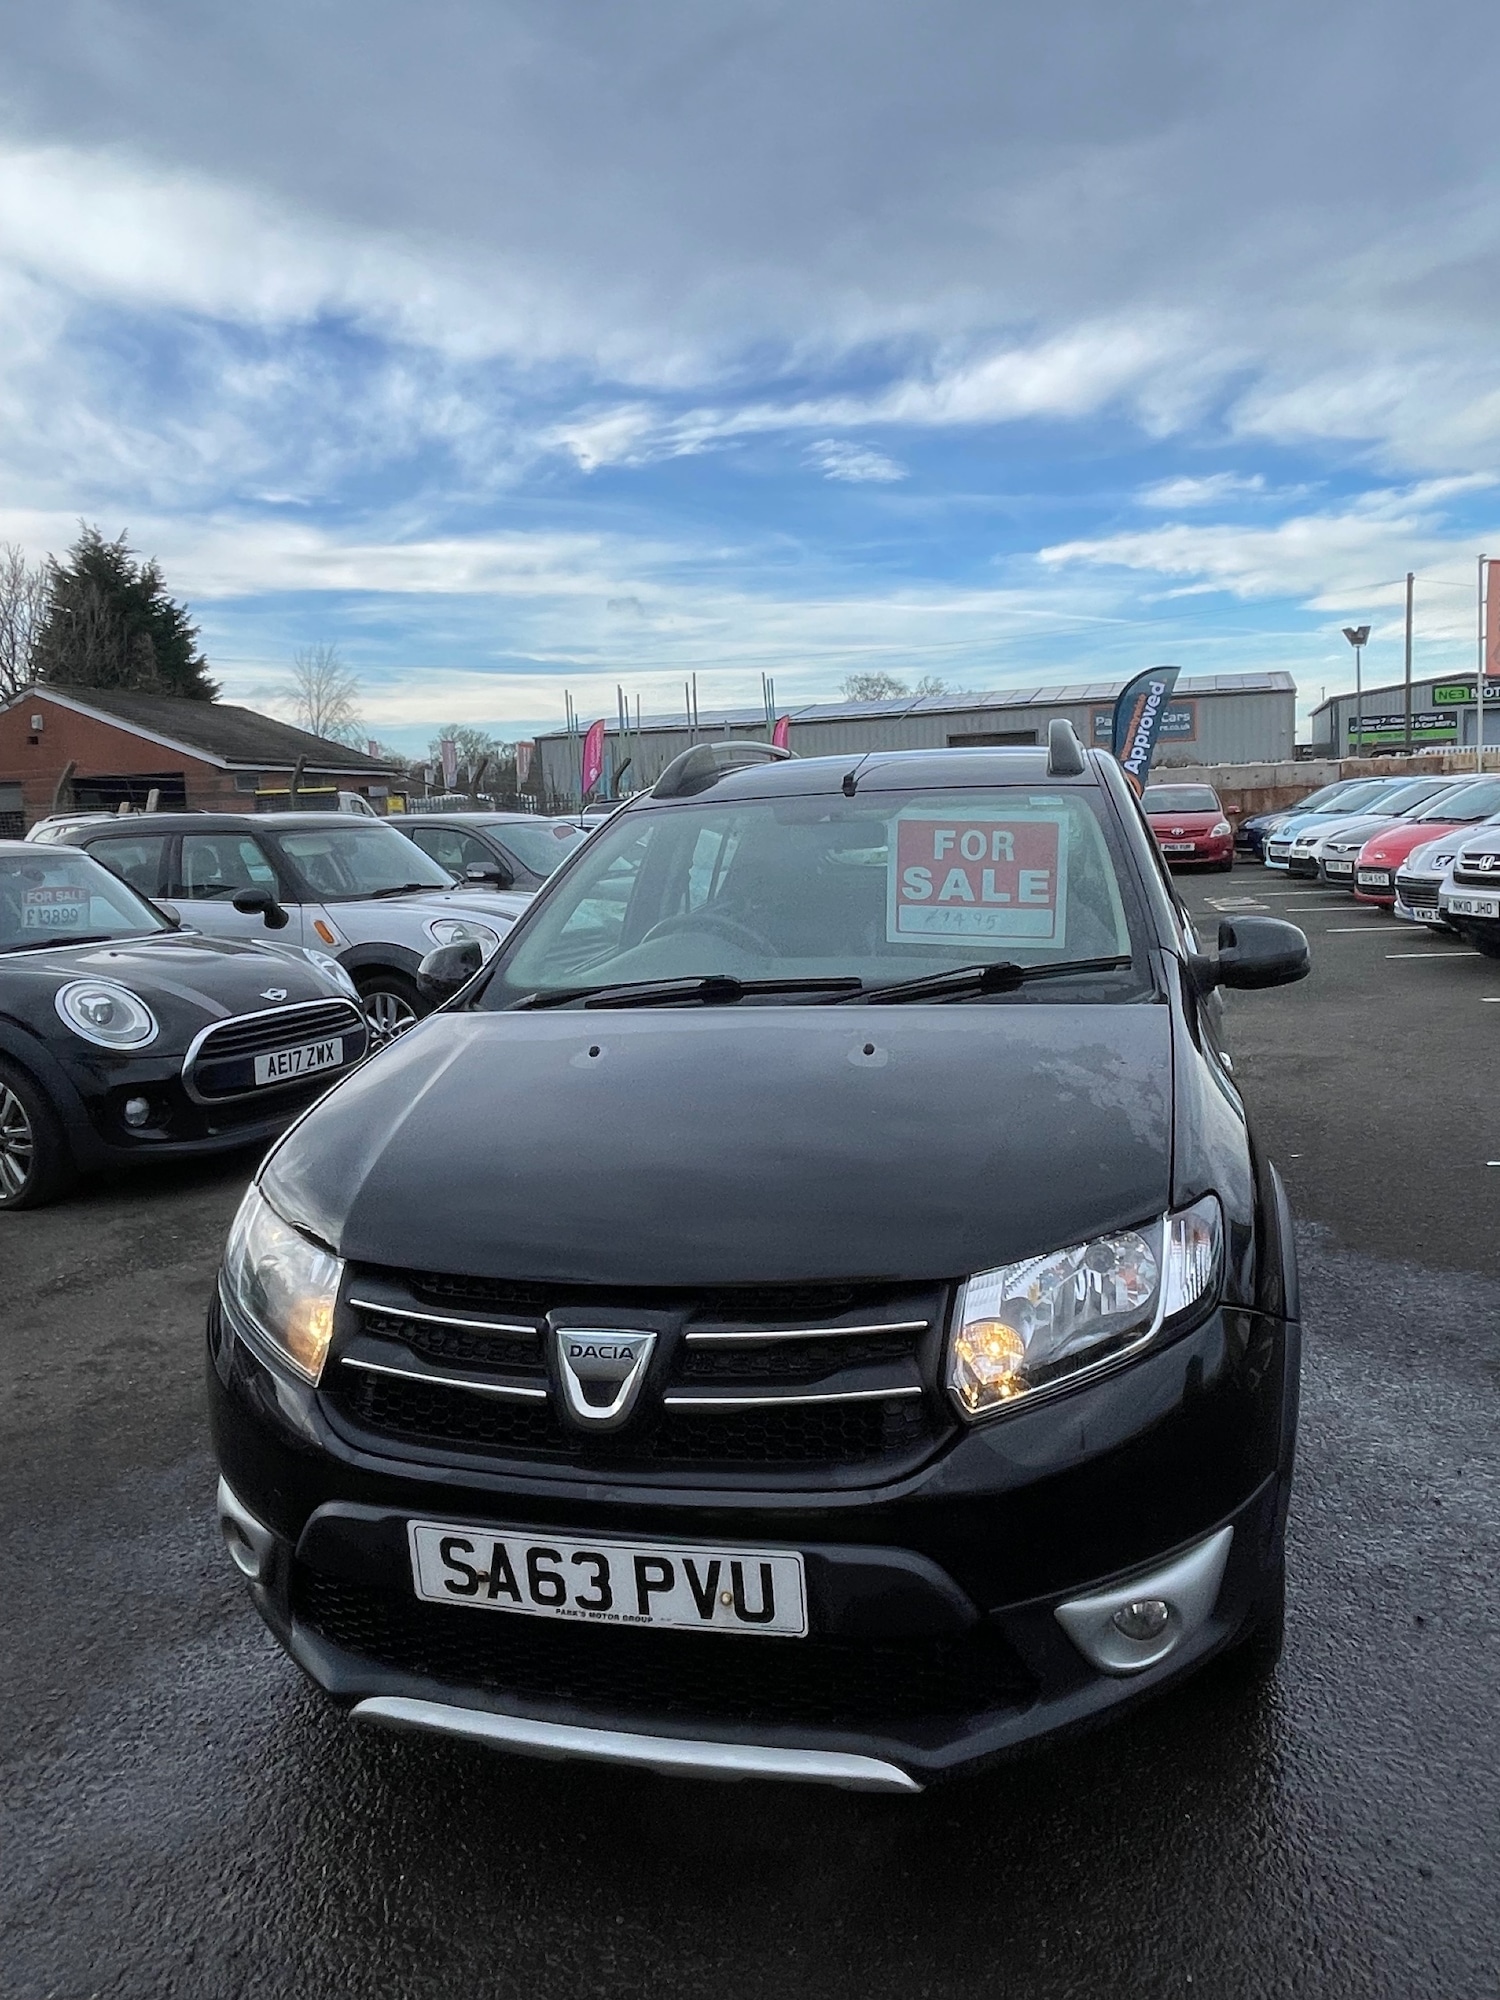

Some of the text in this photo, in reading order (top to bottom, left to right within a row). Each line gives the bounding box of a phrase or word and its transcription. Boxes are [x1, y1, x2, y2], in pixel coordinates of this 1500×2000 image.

[1438, 689, 1465, 700] NE3
[1124, 681, 1166, 775] Approved
[1161, 711, 1191, 723] Cars
[933, 829, 1015, 862] FOR
[26, 889, 87, 903] FOR SALE
[901, 866, 1050, 904] SALE
[267, 1041, 335, 1079] AE17 ZWX
[569, 1344, 634, 1360] DACIA
[438, 1536, 777, 1625] SA63 PVU
[588, 1611, 620, 1621] MOTOR
[622, 1614, 654, 1624] GROUP
